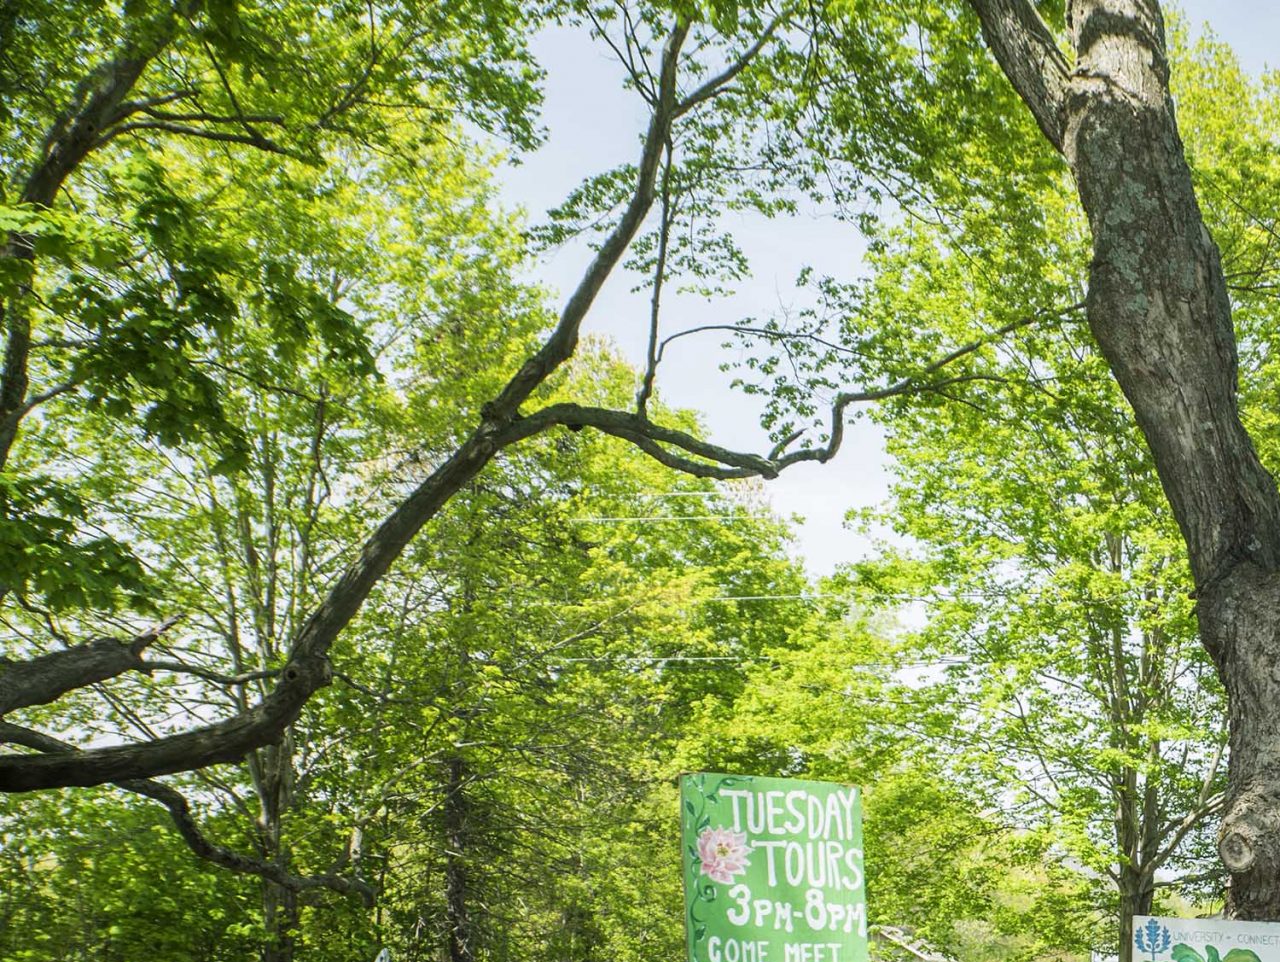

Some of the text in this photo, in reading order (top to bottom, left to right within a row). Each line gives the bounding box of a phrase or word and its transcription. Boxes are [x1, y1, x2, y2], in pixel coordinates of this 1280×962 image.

[719, 788, 856, 840] TUESDAY
[751, 839, 864, 891] TOURS
[726, 884, 867, 938] 3PM-8PM
[1173, 930, 1224, 943] UNIVERSITY
